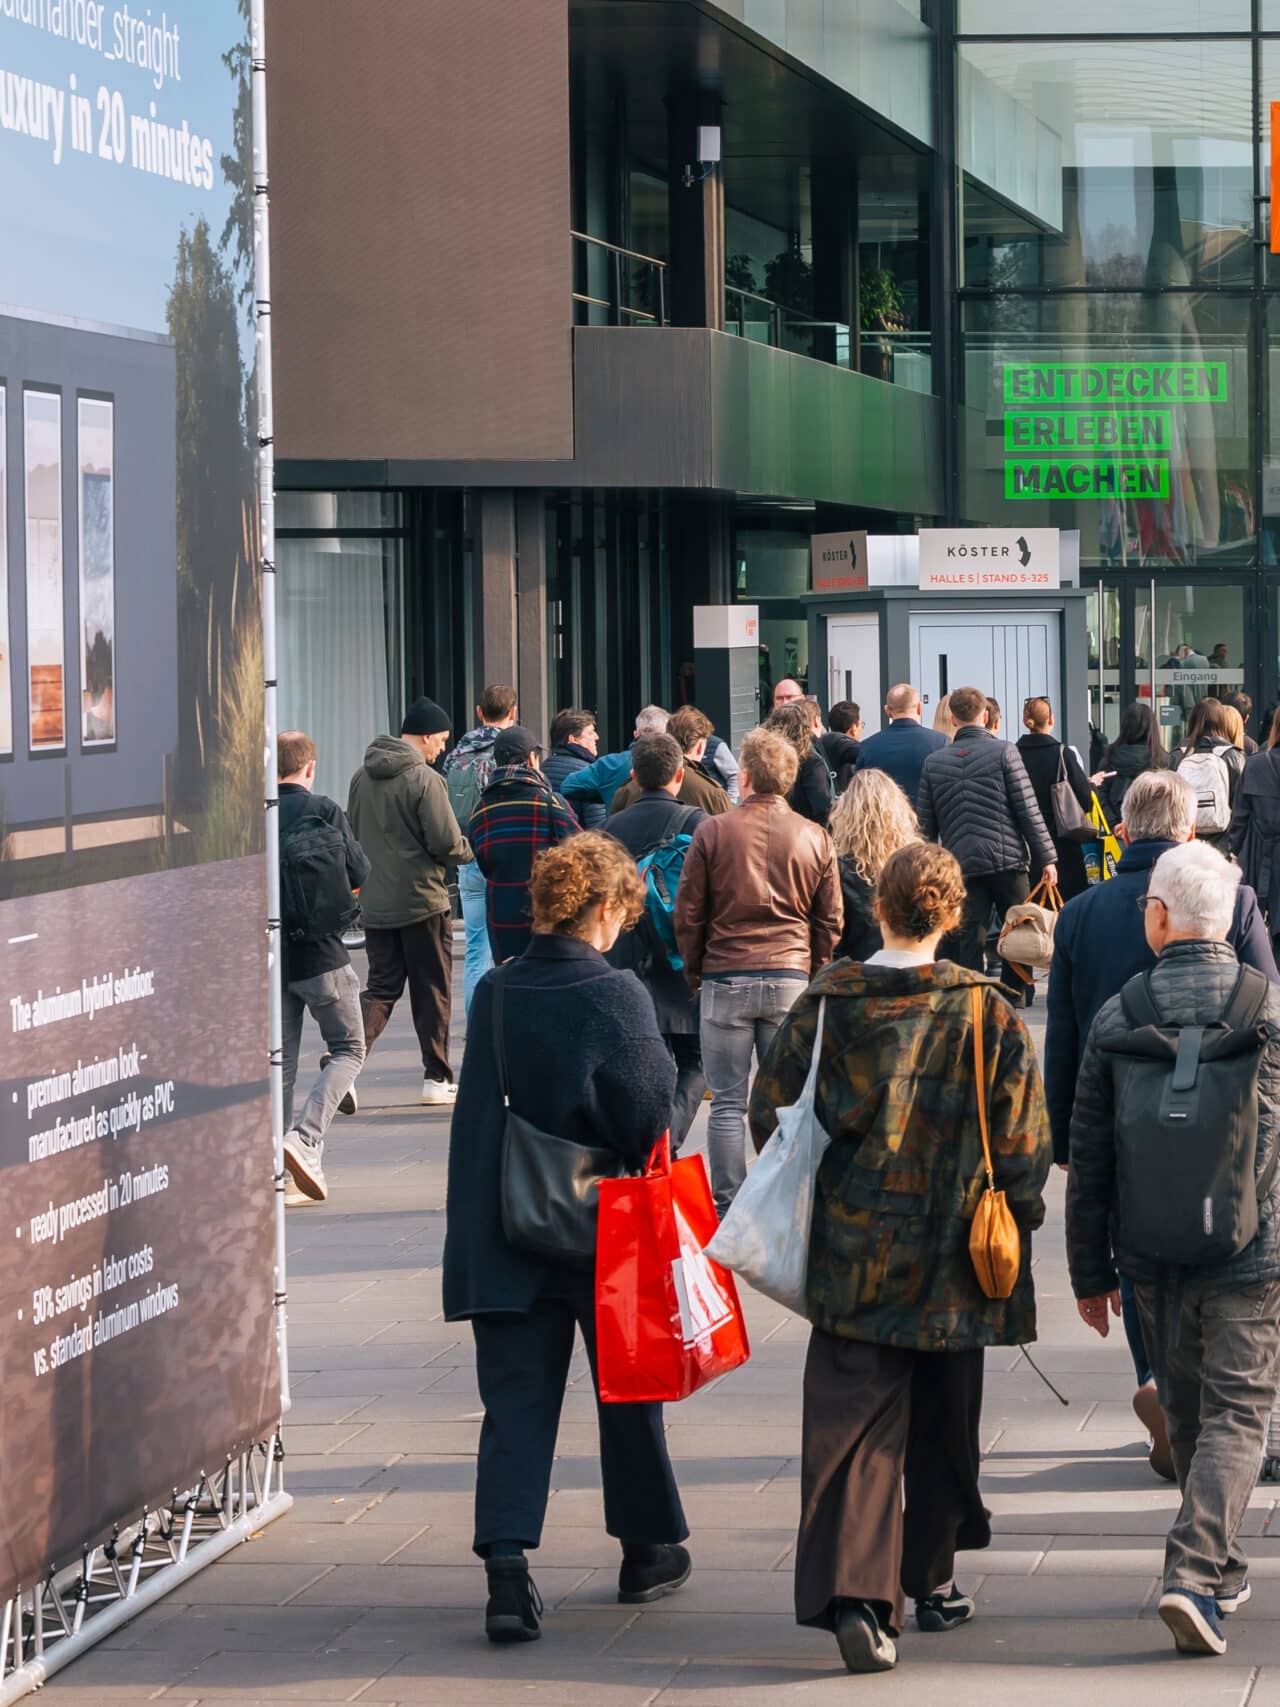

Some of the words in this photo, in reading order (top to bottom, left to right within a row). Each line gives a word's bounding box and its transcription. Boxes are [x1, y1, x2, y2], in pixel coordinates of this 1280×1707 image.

[0, 0, 181, 90] aamander_straight
[70, 73, 92, 154] in
[97, 86, 126, 164] 20
[130, 101, 214, 190] minutes
[1011, 367, 1219, 399] ENTDECKEN
[1012, 415, 1164, 446] ERLEBEN
[1013, 464, 1162, 494] MACHEN
[822, 549, 848, 561] KÖSTER
[929, 573, 966, 584] HALLE
[968, 573, 975, 584] 5
[982, 573, 1018, 583] STAND
[1020, 573, 1049, 583] 5-325
[947, 543, 1010, 557] KÖSTER
[1172, 671, 1219, 683] Eingang
[9, 996, 31, 1032] The
[32, 986, 82, 1027] aluminum
[82, 972, 113, 1020] hybrid
[114, 966, 155, 1004] solution:
[27, 1068, 72, 1119] premium
[72, 1055, 118, 1096] aluminum
[119, 1042, 140, 1080] look
[29, 1105, 96, 1162] manufactured
[97, 1110, 109, 1138] as
[110, 1091, 142, 1140] quickly
[143, 1094, 154, 1121] as
[155, 1080, 175, 1116] PVC
[31, 1201, 60, 1244] ready
[60, 1178, 109, 1241] processed
[109, 1178, 118, 1211] in
[119, 1172, 132, 1206] 20
[133, 1163, 169, 1200] minutes
[33, 1285, 55, 1325] 50%
[56, 1274, 92, 1312] savings
[92, 1264, 103, 1296] in
[103, 1254, 127, 1291] labor
[128, 1244, 153, 1280] costs
[33, 1347, 50, 1376] vs.
[50, 1315, 93, 1369] standard
[94, 1304, 140, 1347] aluminum
[139, 1282, 179, 1322] windows
